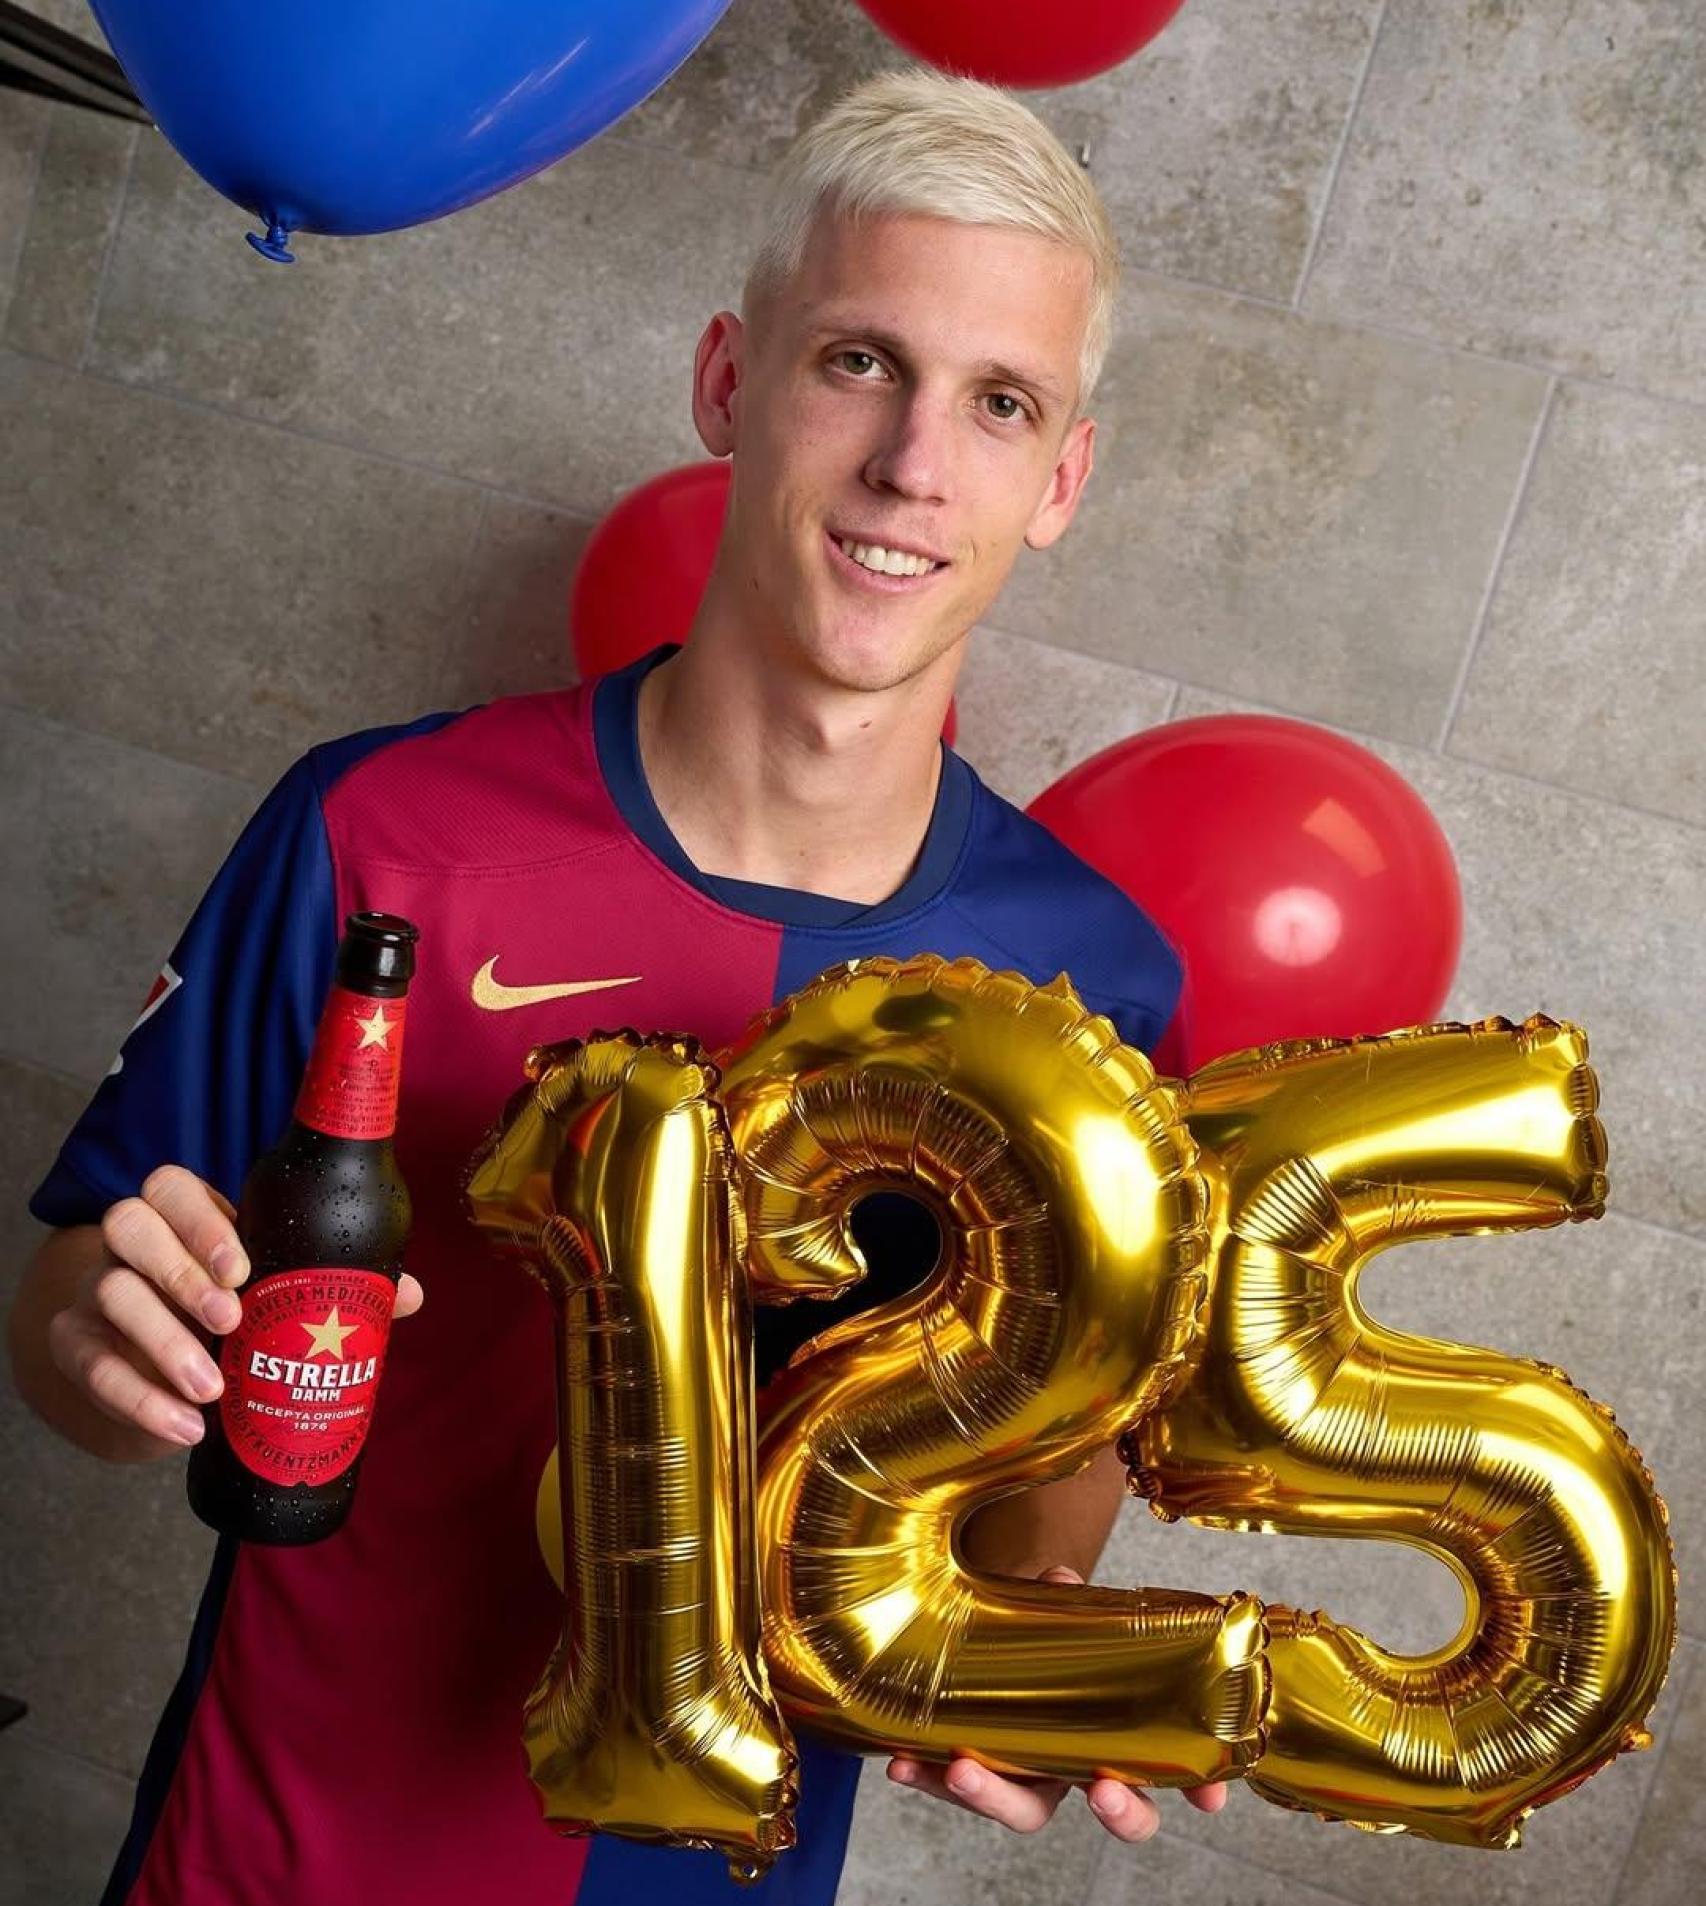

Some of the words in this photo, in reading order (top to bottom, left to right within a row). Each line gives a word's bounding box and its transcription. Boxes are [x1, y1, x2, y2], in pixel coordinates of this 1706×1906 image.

[249, 1351, 377, 1388] ESTRELLA
[291, 1388, 342, 1402] DAMM
[247, 1400, 311, 1421] RECEPTA
[313, 1406, 366, 1421] ORIGINAL
[465, 956, 1678, 1880] 125
[293, 1422, 329, 1432] 1876
